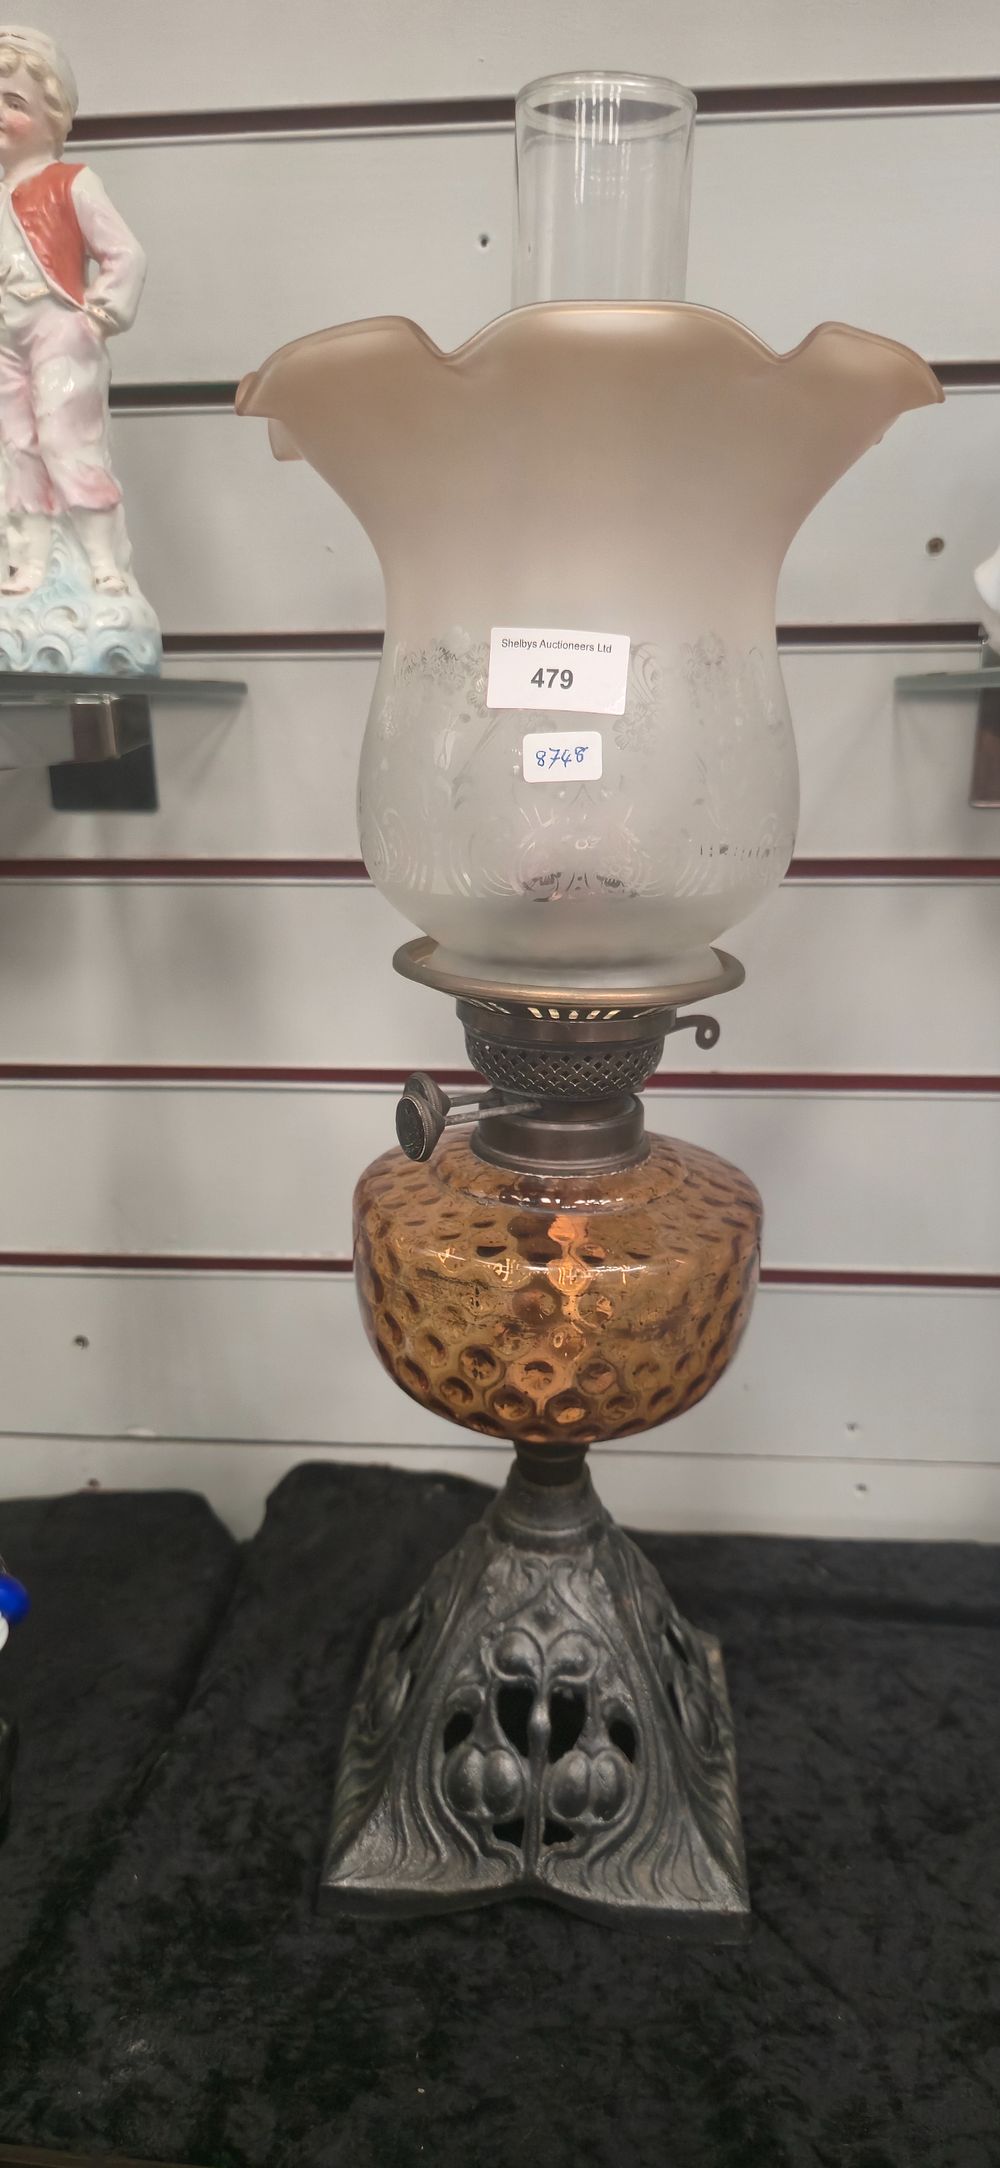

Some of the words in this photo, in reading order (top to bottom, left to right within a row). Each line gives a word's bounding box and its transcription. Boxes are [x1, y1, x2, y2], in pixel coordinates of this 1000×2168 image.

[501, 638, 538, 649] Shelbys
[539, 639, 595, 652] Auctioneers
[597, 643, 612, 654] Ltd
[530, 667, 574, 690] 479
[535, 746, 589, 769] 8748
